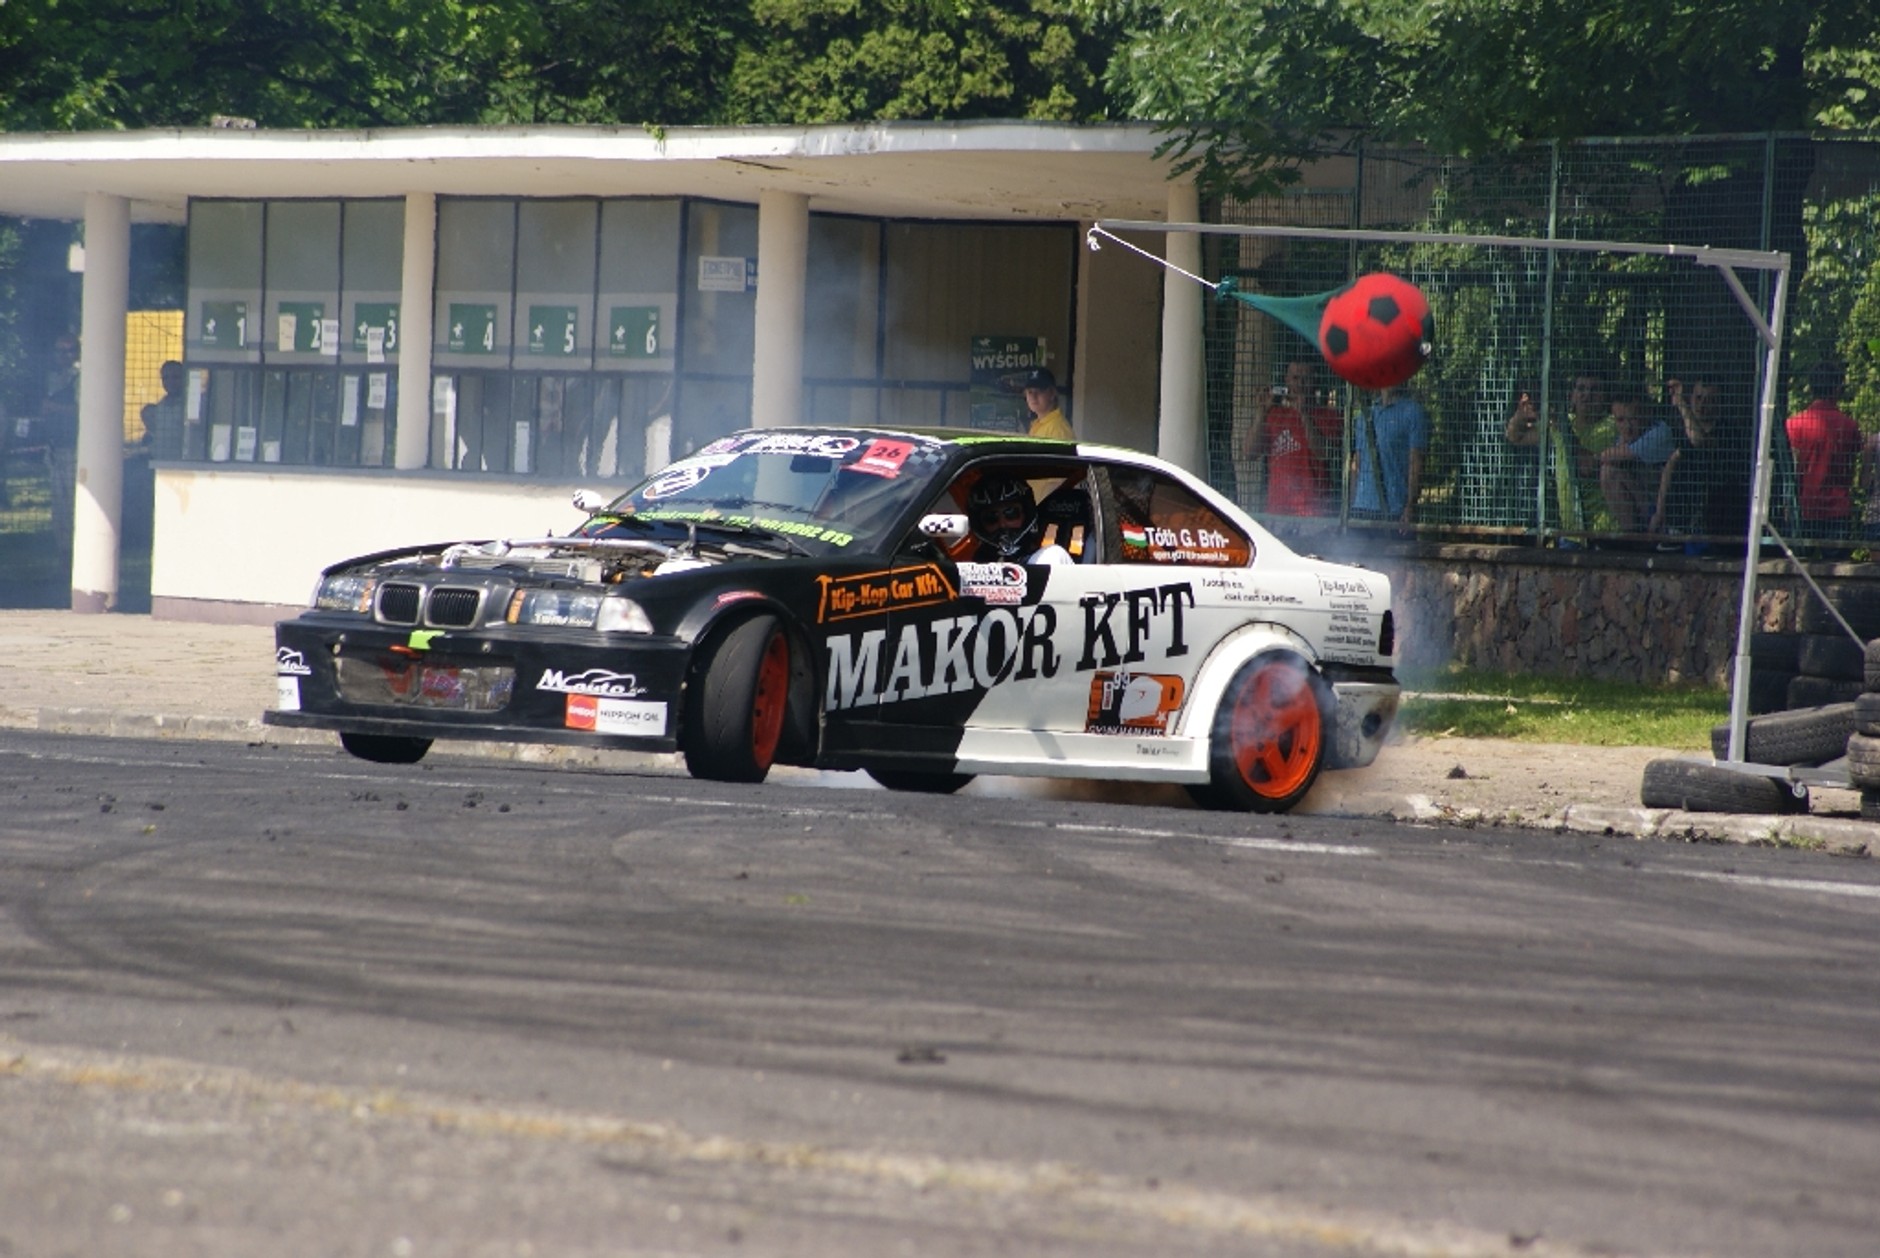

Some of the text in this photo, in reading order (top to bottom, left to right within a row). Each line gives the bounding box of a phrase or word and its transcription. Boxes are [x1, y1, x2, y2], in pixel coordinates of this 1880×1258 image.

[237, 317, 246, 347] 1
[310, 319, 321, 349] 2
[385, 319, 396, 349] 3
[482, 321, 493, 351] 4
[563, 323, 575, 354] 5
[645, 324, 657, 355] 6
[872, 446, 901, 459] 26
[1144, 526, 1178, 547] Tóth
[1180, 528, 1197, 547] G.
[891, 579, 914, 600] Car
[825, 582, 1195, 712] MAKOR KFT
